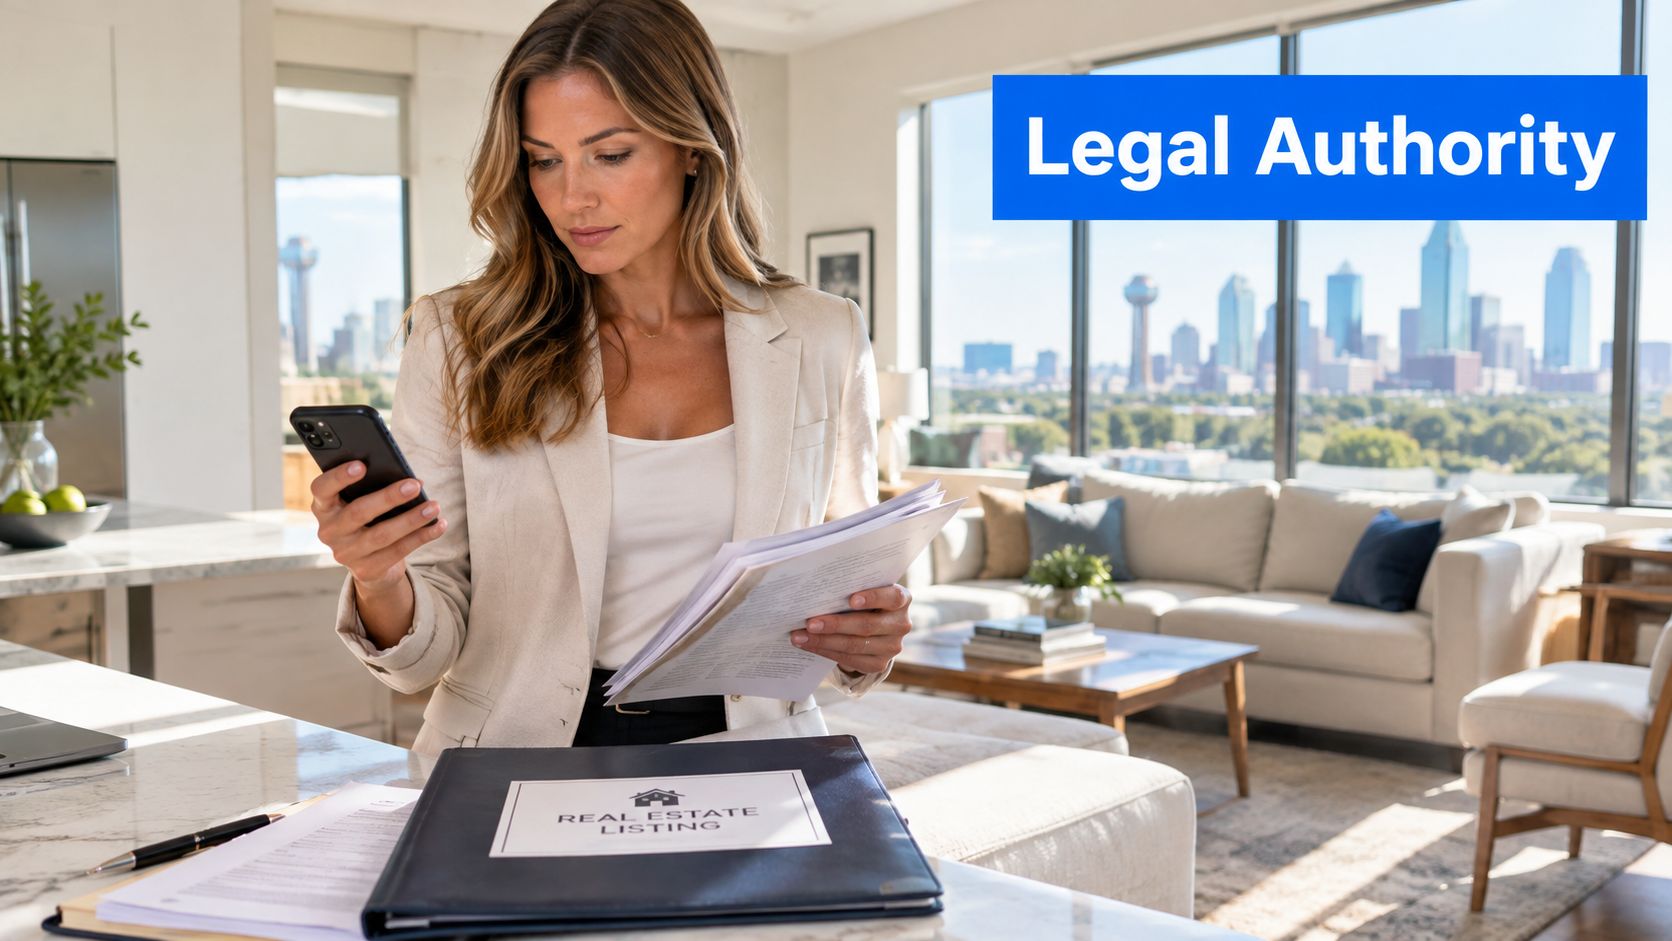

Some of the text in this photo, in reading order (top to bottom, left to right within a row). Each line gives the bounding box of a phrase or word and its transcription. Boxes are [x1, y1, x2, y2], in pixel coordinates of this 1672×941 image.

[557, 807, 759, 824] REAL ESTATE
[600, 821, 721, 835] LISTING
